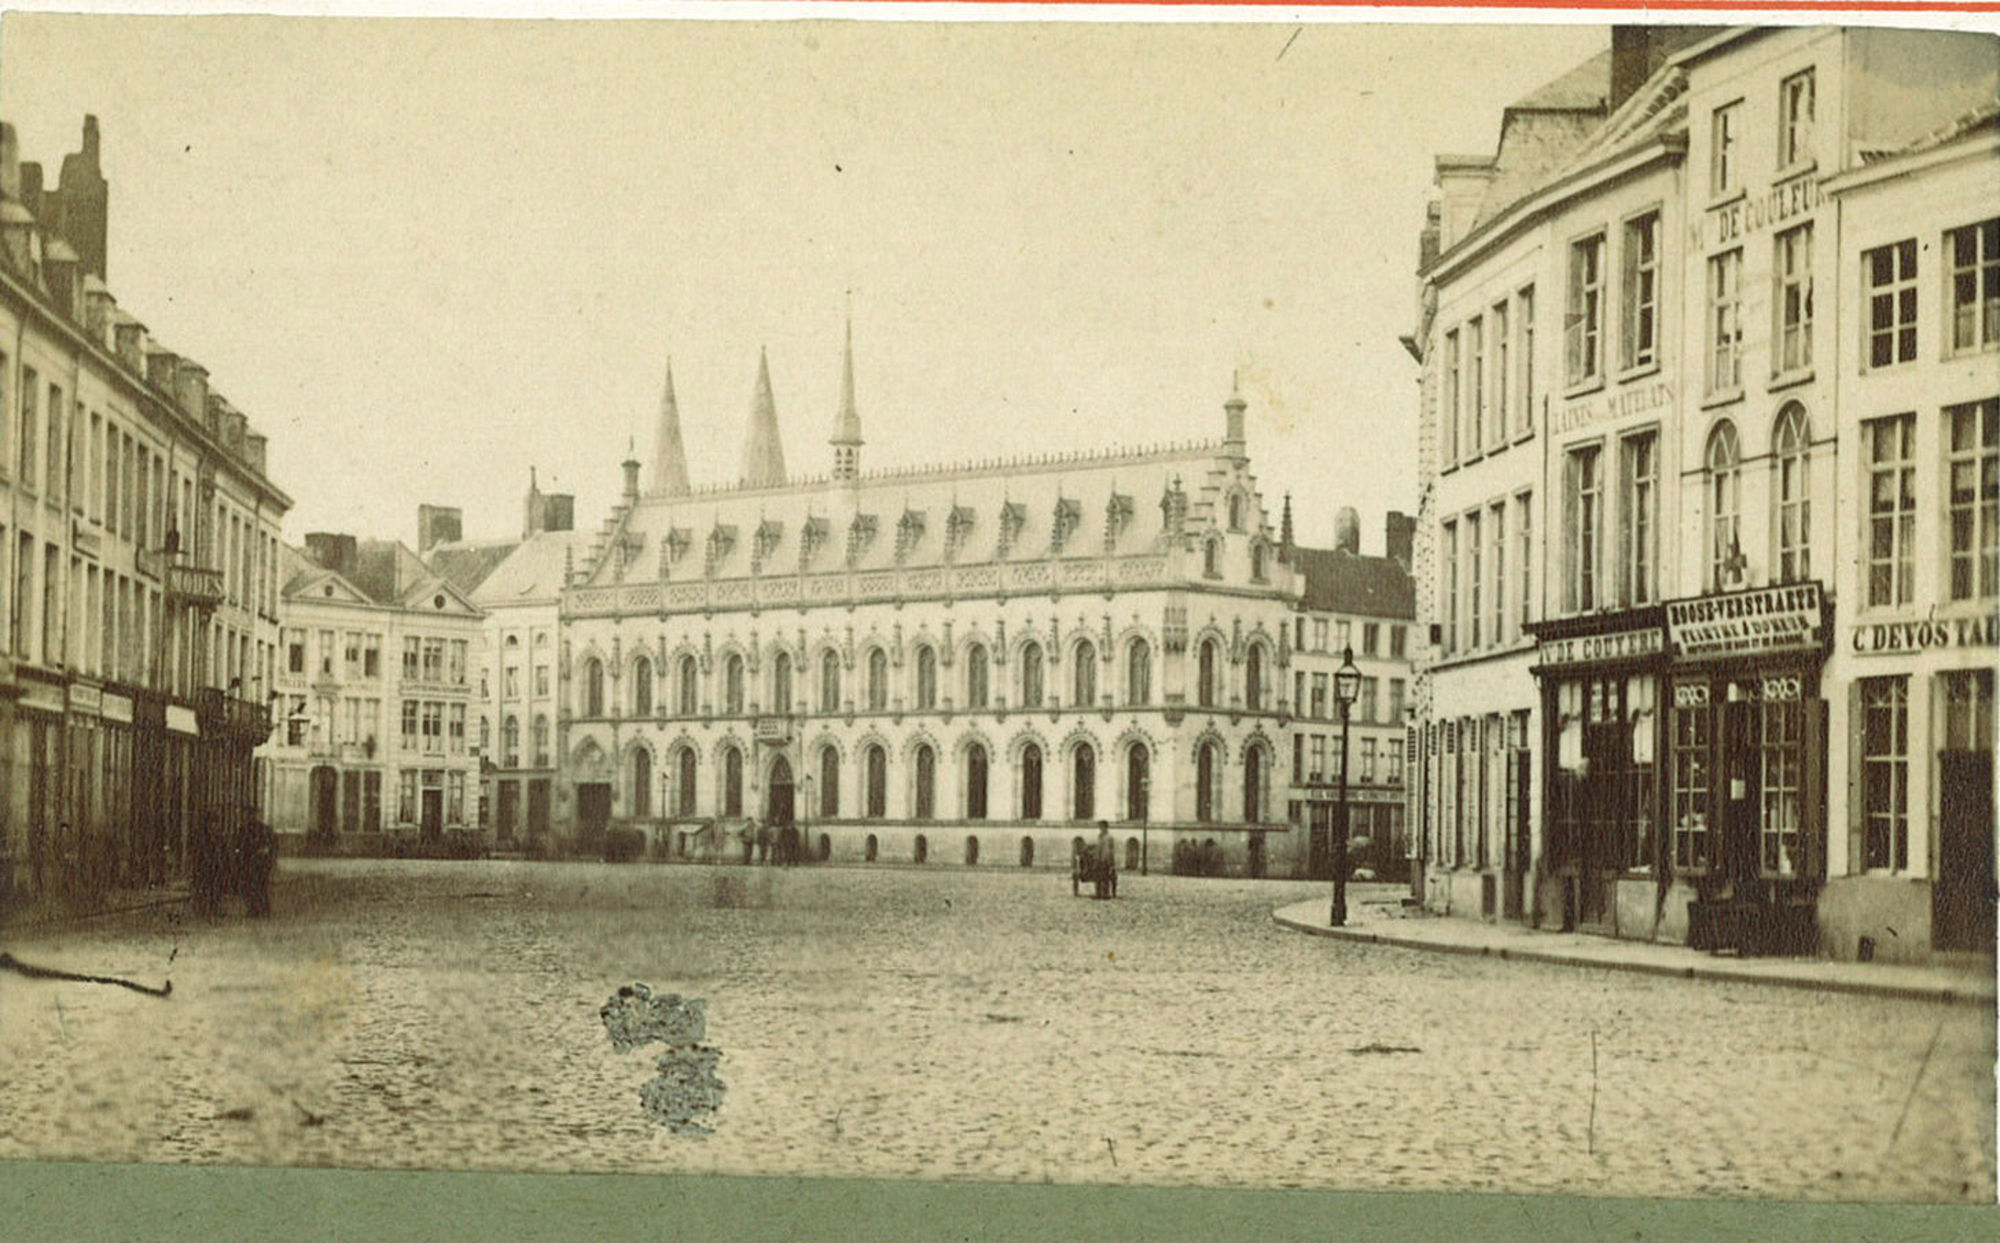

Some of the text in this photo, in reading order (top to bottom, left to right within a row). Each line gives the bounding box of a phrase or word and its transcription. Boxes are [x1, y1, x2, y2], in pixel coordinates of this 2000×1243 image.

[1719, 205, 1739, 243] DE
[1557, 640, 1574, 662] DE
[1872, 620, 1949, 651] DEVOS
